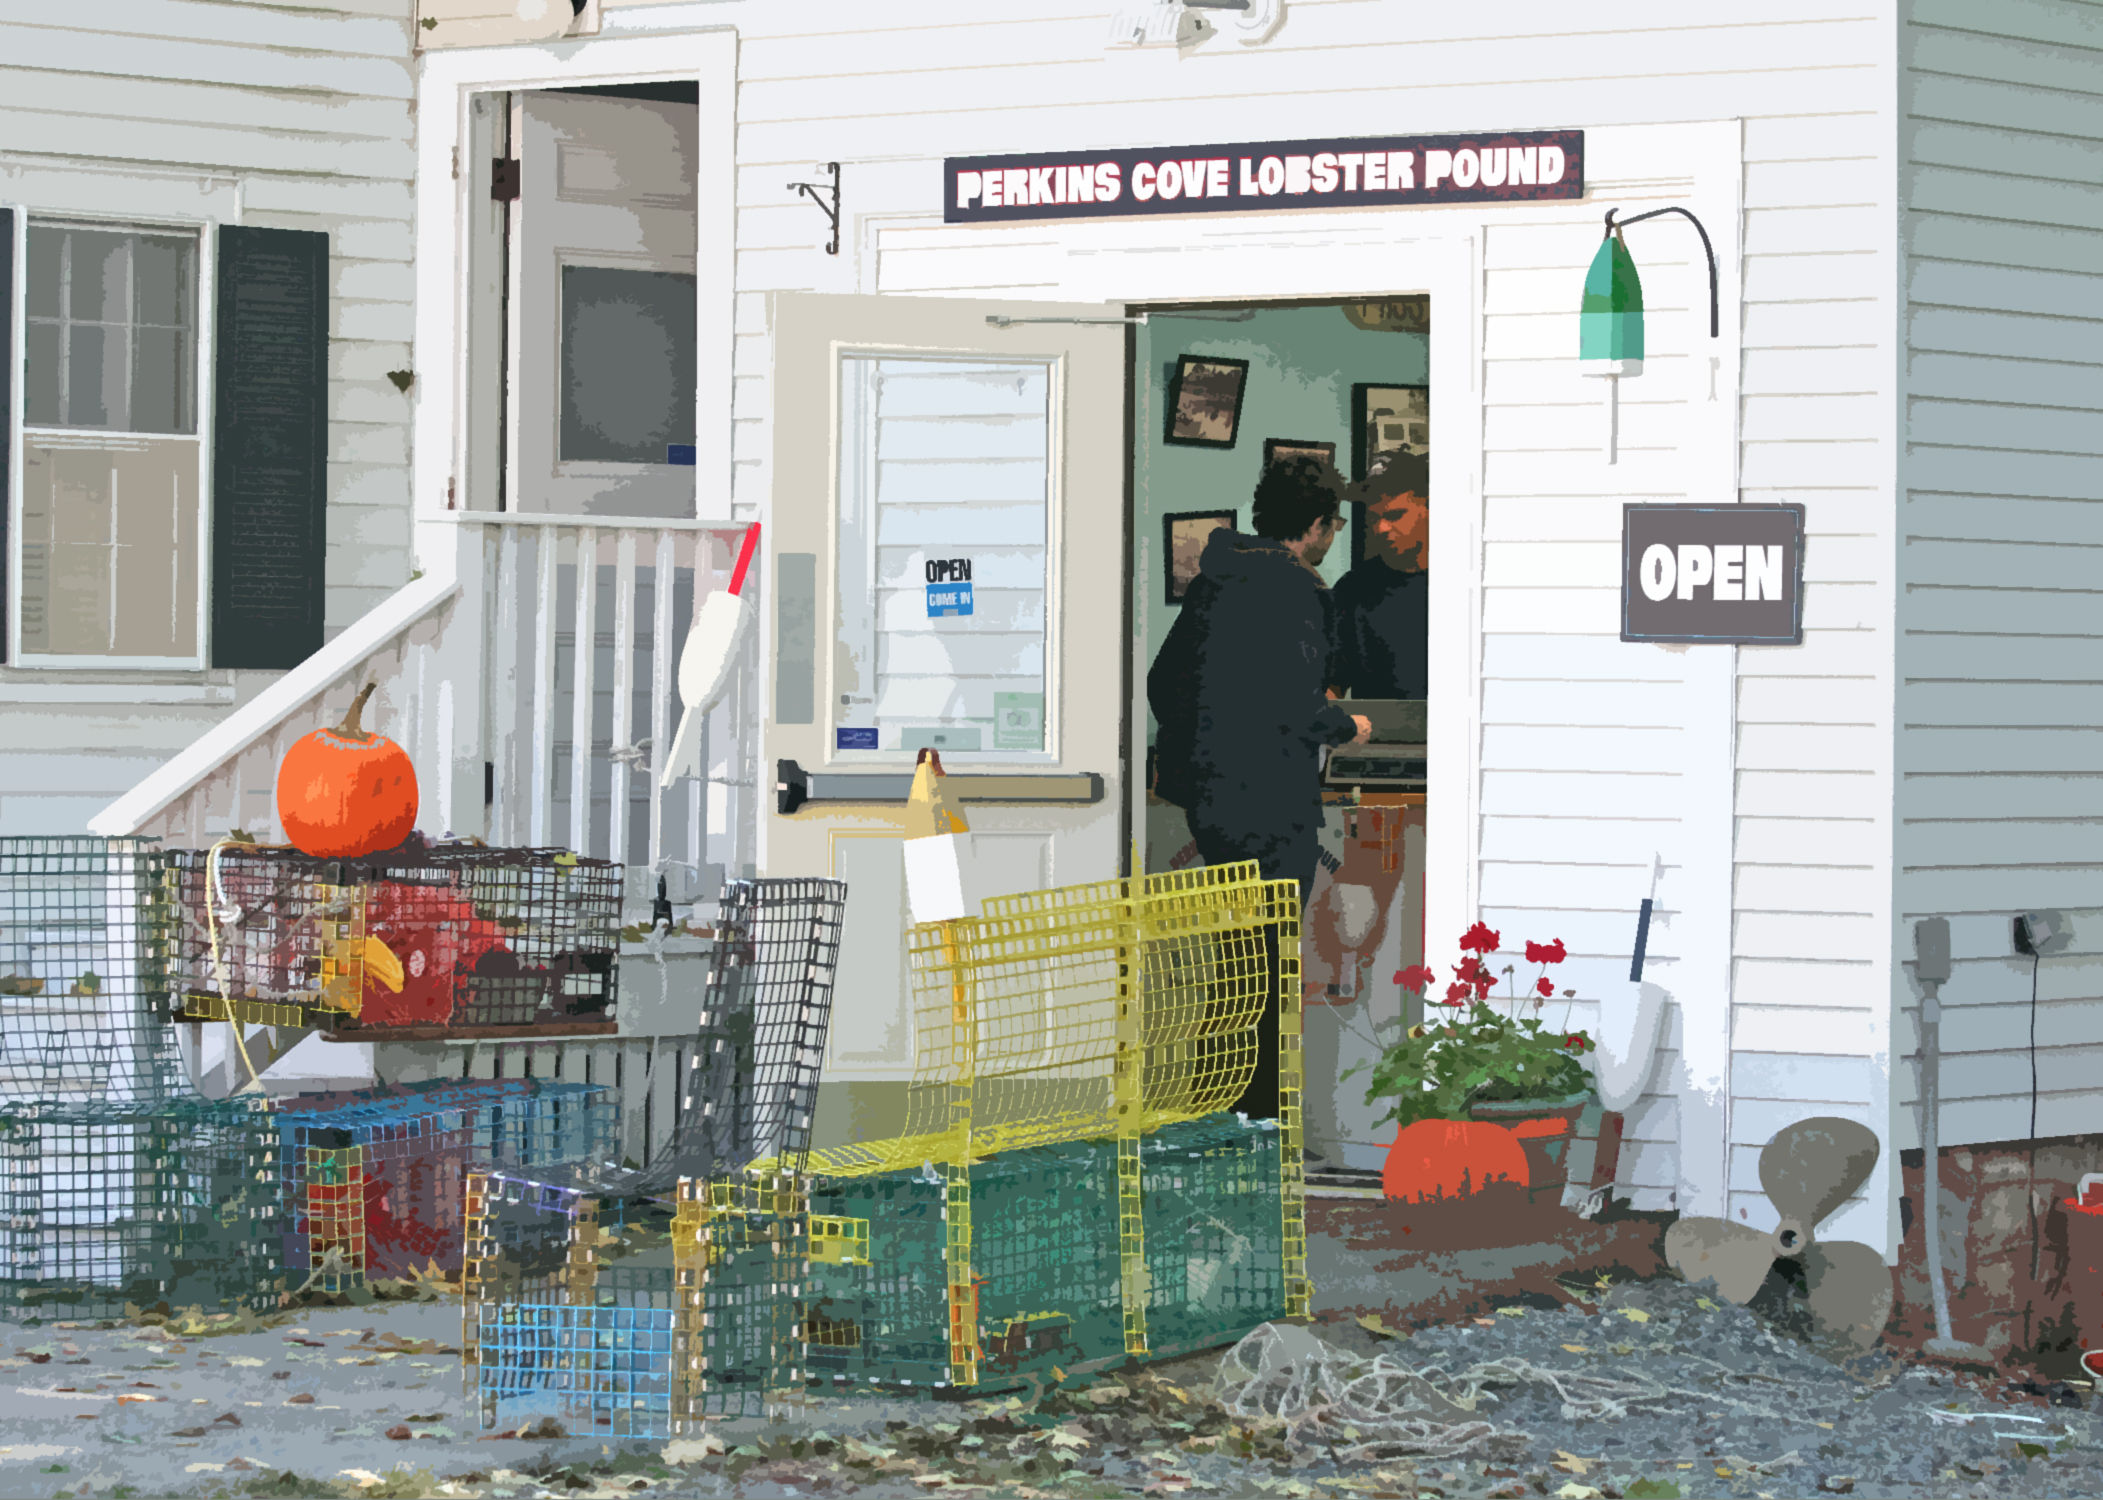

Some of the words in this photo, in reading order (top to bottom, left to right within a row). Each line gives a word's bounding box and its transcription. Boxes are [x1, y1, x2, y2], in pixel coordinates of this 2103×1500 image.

[957, 162, 1121, 209] PERKINS
[1132, 158, 1230, 201] COVE
[1239, 151, 1415, 195] LOBSTER
[1425, 145, 1566, 188] POUND
[926, 559, 972, 583] OPEN
[1640, 543, 1783, 601] OPEN
[929, 593, 958, 606] COME
[960, 591, 971, 605] IN
